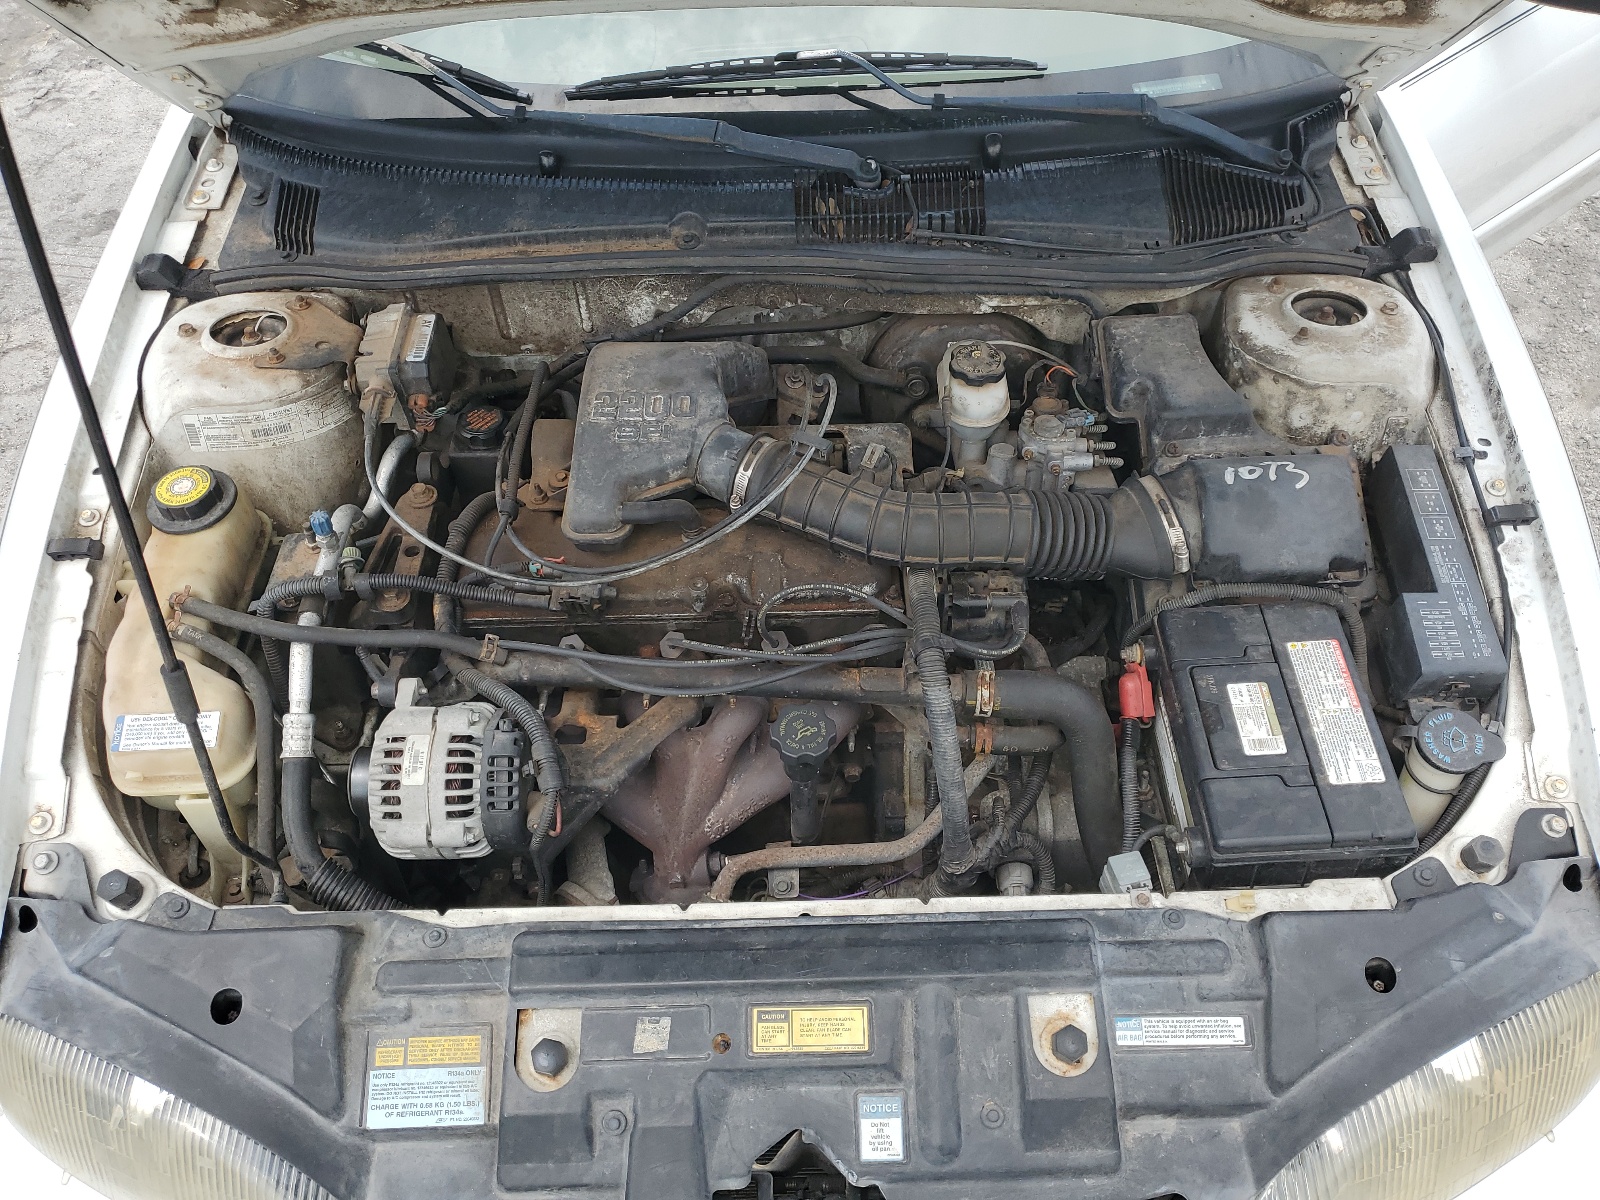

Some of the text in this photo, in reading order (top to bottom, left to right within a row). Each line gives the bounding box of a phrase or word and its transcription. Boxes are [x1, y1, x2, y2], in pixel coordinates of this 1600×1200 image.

[590, 390, 698, 422] 2200
[1428, 712, 1454, 727] FLUID
[1424, 731, 1451, 764] WASHER
[1474, 734, 1483, 755] ONLY
[863, 1104, 898, 1113] NOTICE
